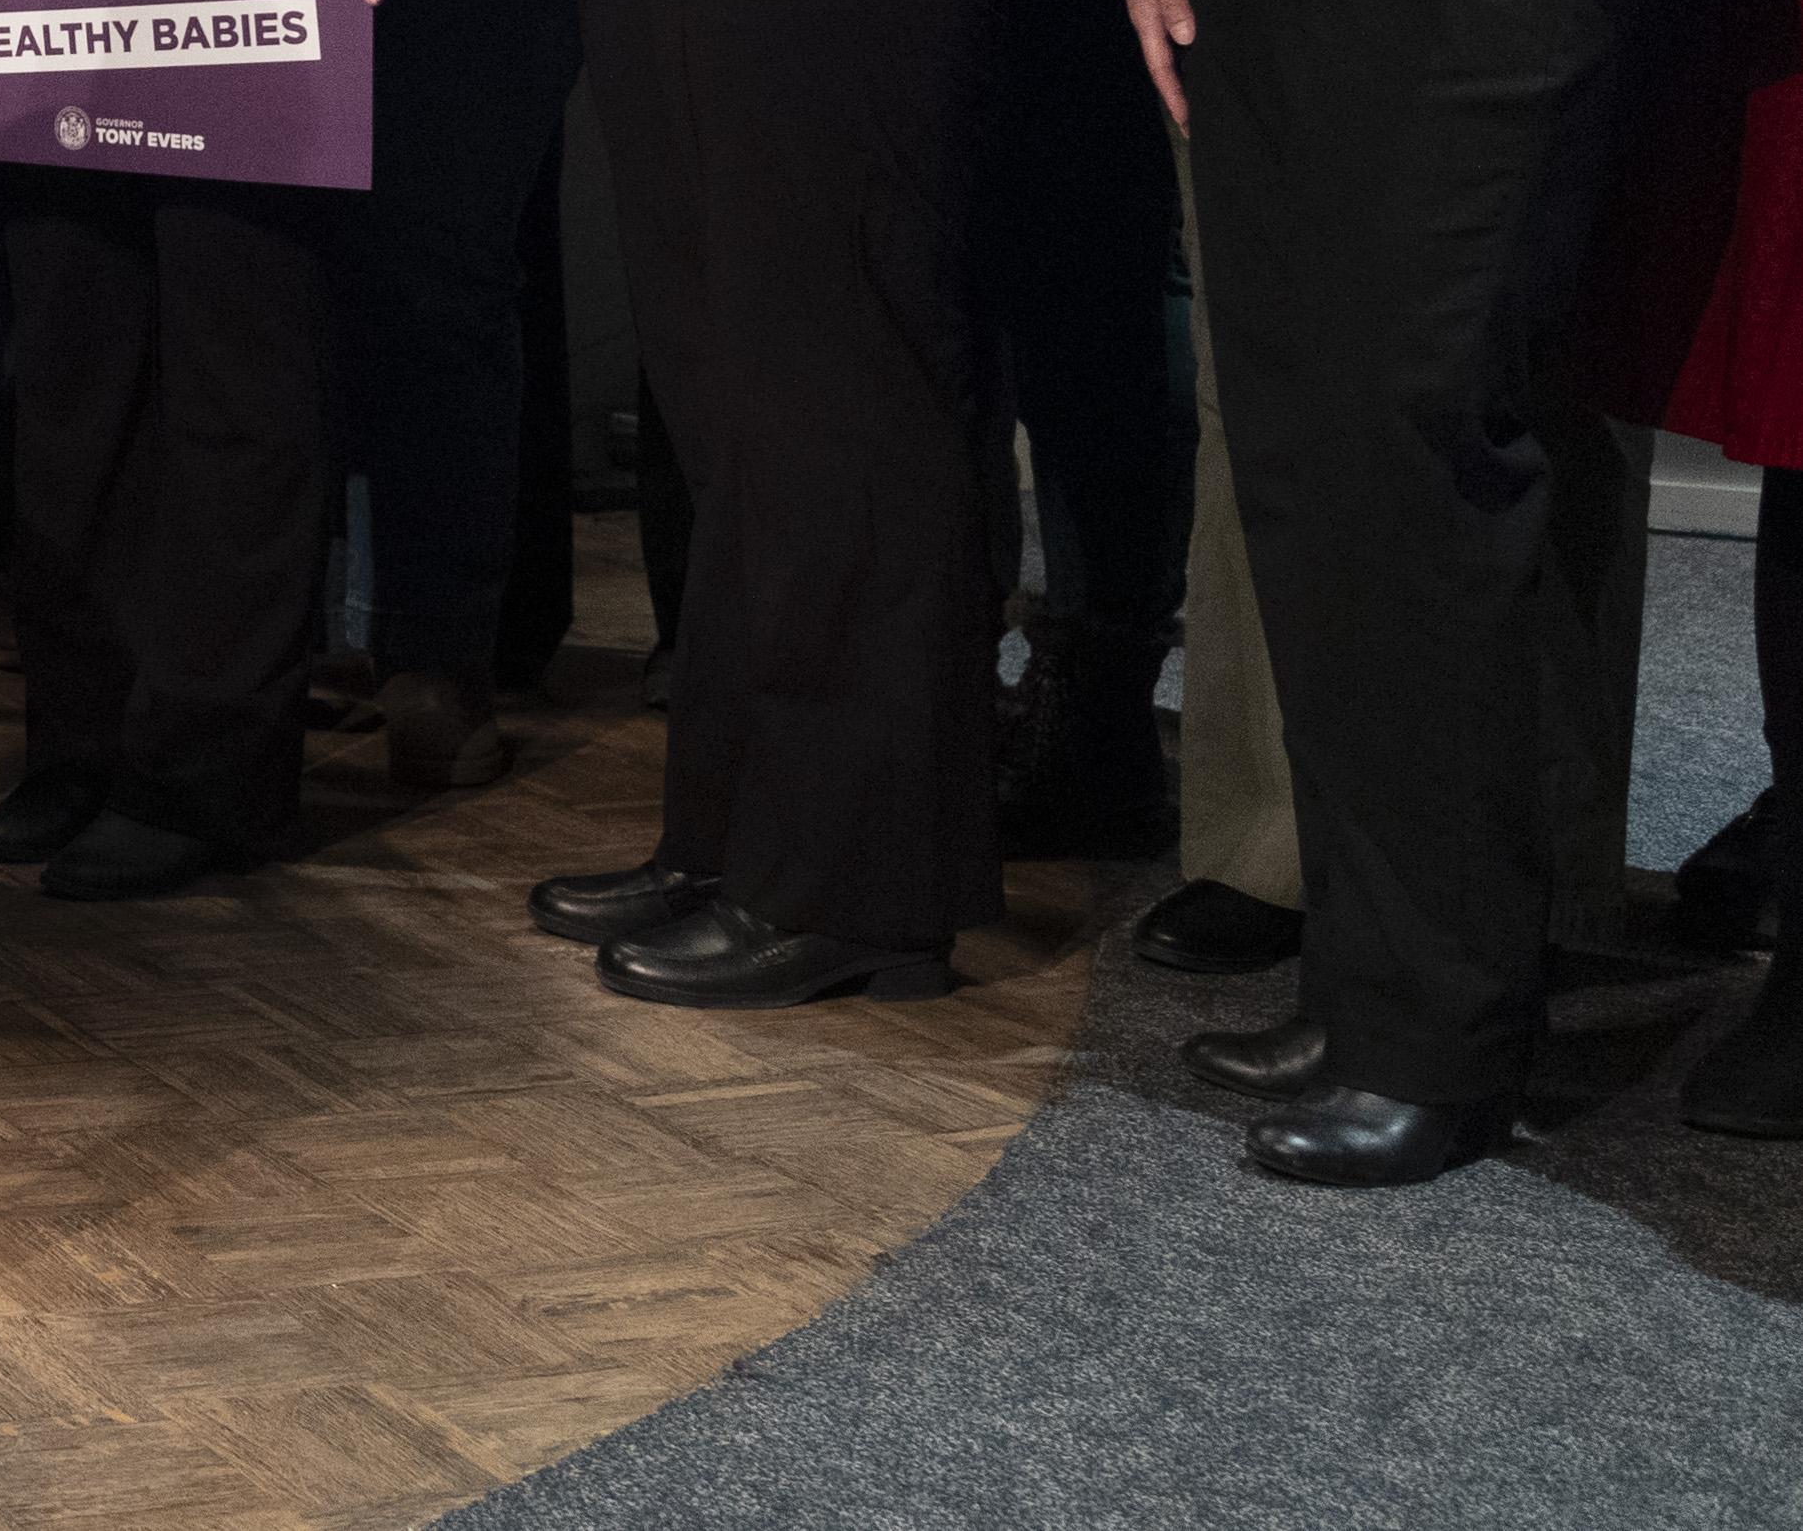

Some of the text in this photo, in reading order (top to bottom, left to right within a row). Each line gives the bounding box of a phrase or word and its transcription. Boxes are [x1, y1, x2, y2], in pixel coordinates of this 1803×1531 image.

[152, 11, 307, 51] BABIES
[96, 118, 143, 128] GOVERNOR
[96, 128, 204, 150] TONY EVERS
